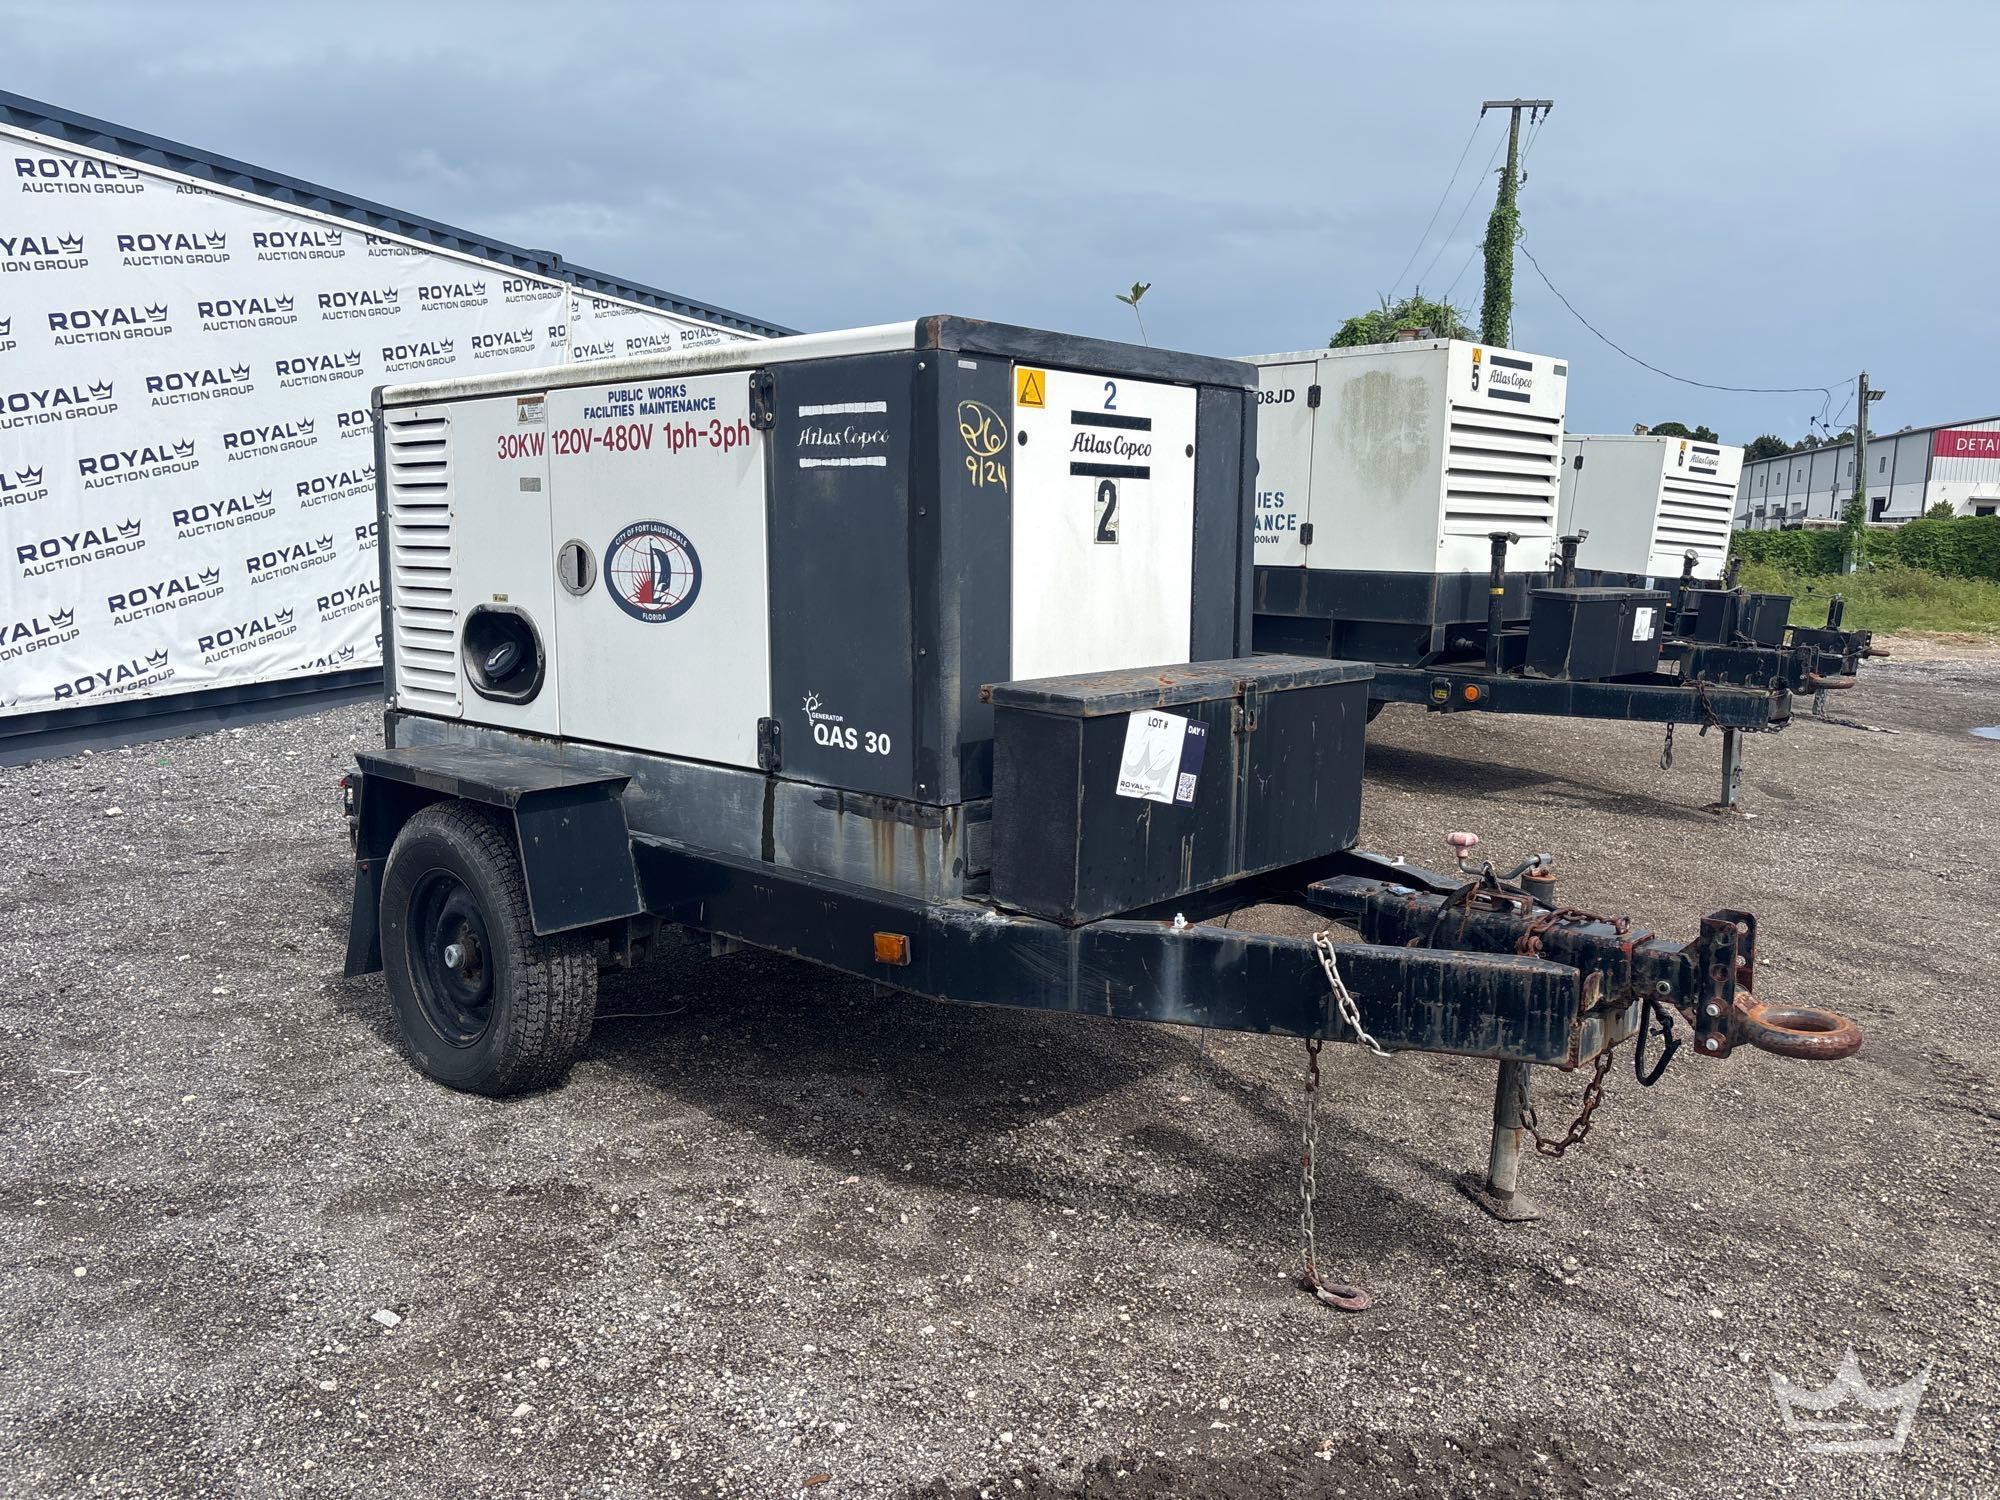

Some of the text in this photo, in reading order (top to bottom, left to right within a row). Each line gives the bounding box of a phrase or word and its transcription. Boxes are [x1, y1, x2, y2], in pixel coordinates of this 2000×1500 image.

[15, 158, 117, 179] ROYAL
[21, 182, 145, 194] AUCTION GROUP
[117, 233, 206, 252] ROYAL
[253, 231, 325, 249] ROYAL
[123, 253, 230, 267] AUCTION GROUP
[257, 249, 345, 262] AUCTION GROUP
[367, 248, 410, 257] AUCTION
[34, 259, 88, 271] GROUP
[318, 290, 382, 309] ROYAL
[419, 283, 473, 301] ROYAL
[505, 291, 561, 303] AUCTION GROUP
[198, 297, 276, 318] ROYAL
[322, 306, 401, 321] AUCTION GROUP
[421, 298, 488, 312] AUCTION GROUP
[48, 307, 146, 331] ROYAL
[202, 315, 298, 332] AUCTION GROUP
[54, 326, 173, 346] AUCTION GROUP
[472, 330, 522, 349] ROYAL
[626, 335, 662, 350] ROYAL
[680, 328, 712, 341] ROYAL
[382, 341, 440, 361] ROYAL
[474, 344, 536, 360] AUCTION GROUP
[276, 354, 346, 376] ROYAL
[385, 355, 456, 373] AUCTION GROUP
[146, 368, 232, 393] ROYAL
[280, 369, 364, 388] AUCTION GROUP
[1471, 364, 1480, 391] 5
[1488, 369, 1532, 390] Atlas Copco
[151, 384, 254, 407] AUCTION GROUP
[608, 384, 687, 403] PUBLIC WORKS
[1103, 381, 1117, 410] 2
[0, 403, 118, 430] UCTION GROUP
[584, 396, 716, 420] FACILITIES MAINTENANCE
[223, 422, 298, 450] ROYAL
[497, 418, 750, 460] 30KW 120V-480V 1ph-3ph
[797, 425, 889, 449] Atlas Copco
[1070, 432, 1152, 460] Atlas Copco
[228, 437, 318, 462] AUCTION GROUP
[1678, 450, 1684, 467] 6
[79, 445, 174, 476] ROYAL
[84, 460, 200, 490] AUCTION GROUP
[296, 470, 363, 498] ROYAL
[0, 489, 48, 508] ROUP
[300, 491, 346, 509] AUCTION
[172, 495, 255, 527] ROYAL
[1096, 479, 1117, 542] 2
[178, 508, 276, 540] AUCTION GROUP
[17, 526, 118, 564] ROYAL
[615, 524, 688, 548] CITY OF FORT LAUDERDALE
[23, 540, 146, 579] AUCTION GROUP
[246, 541, 318, 574] ROYAL
[250, 552, 337, 585] AUCTION GROUP
[108, 574, 200, 613] ROYAL
[317, 580, 380, 612] ROYAL
[113, 586, 224, 626] AUCTION GROUP
[321, 602, 364, 623] AUCTION
[642, 612, 667, 621] FLORIDA
[26, 629, 80, 653] GROUP
[198, 615, 277, 653] ROYAL
[204, 625, 297, 666] AUCTION GROUP
[53, 659, 149, 701] ROYAL
[127, 668, 175, 691] GROUP
[811, 712, 844, 722] GENERATOR
[1147, 717, 1163, 729] LOT
[813, 723, 891, 756] QAS 30
[1187, 725, 1201, 736] DAY
[1120, 780, 1144, 790] ROYAL
